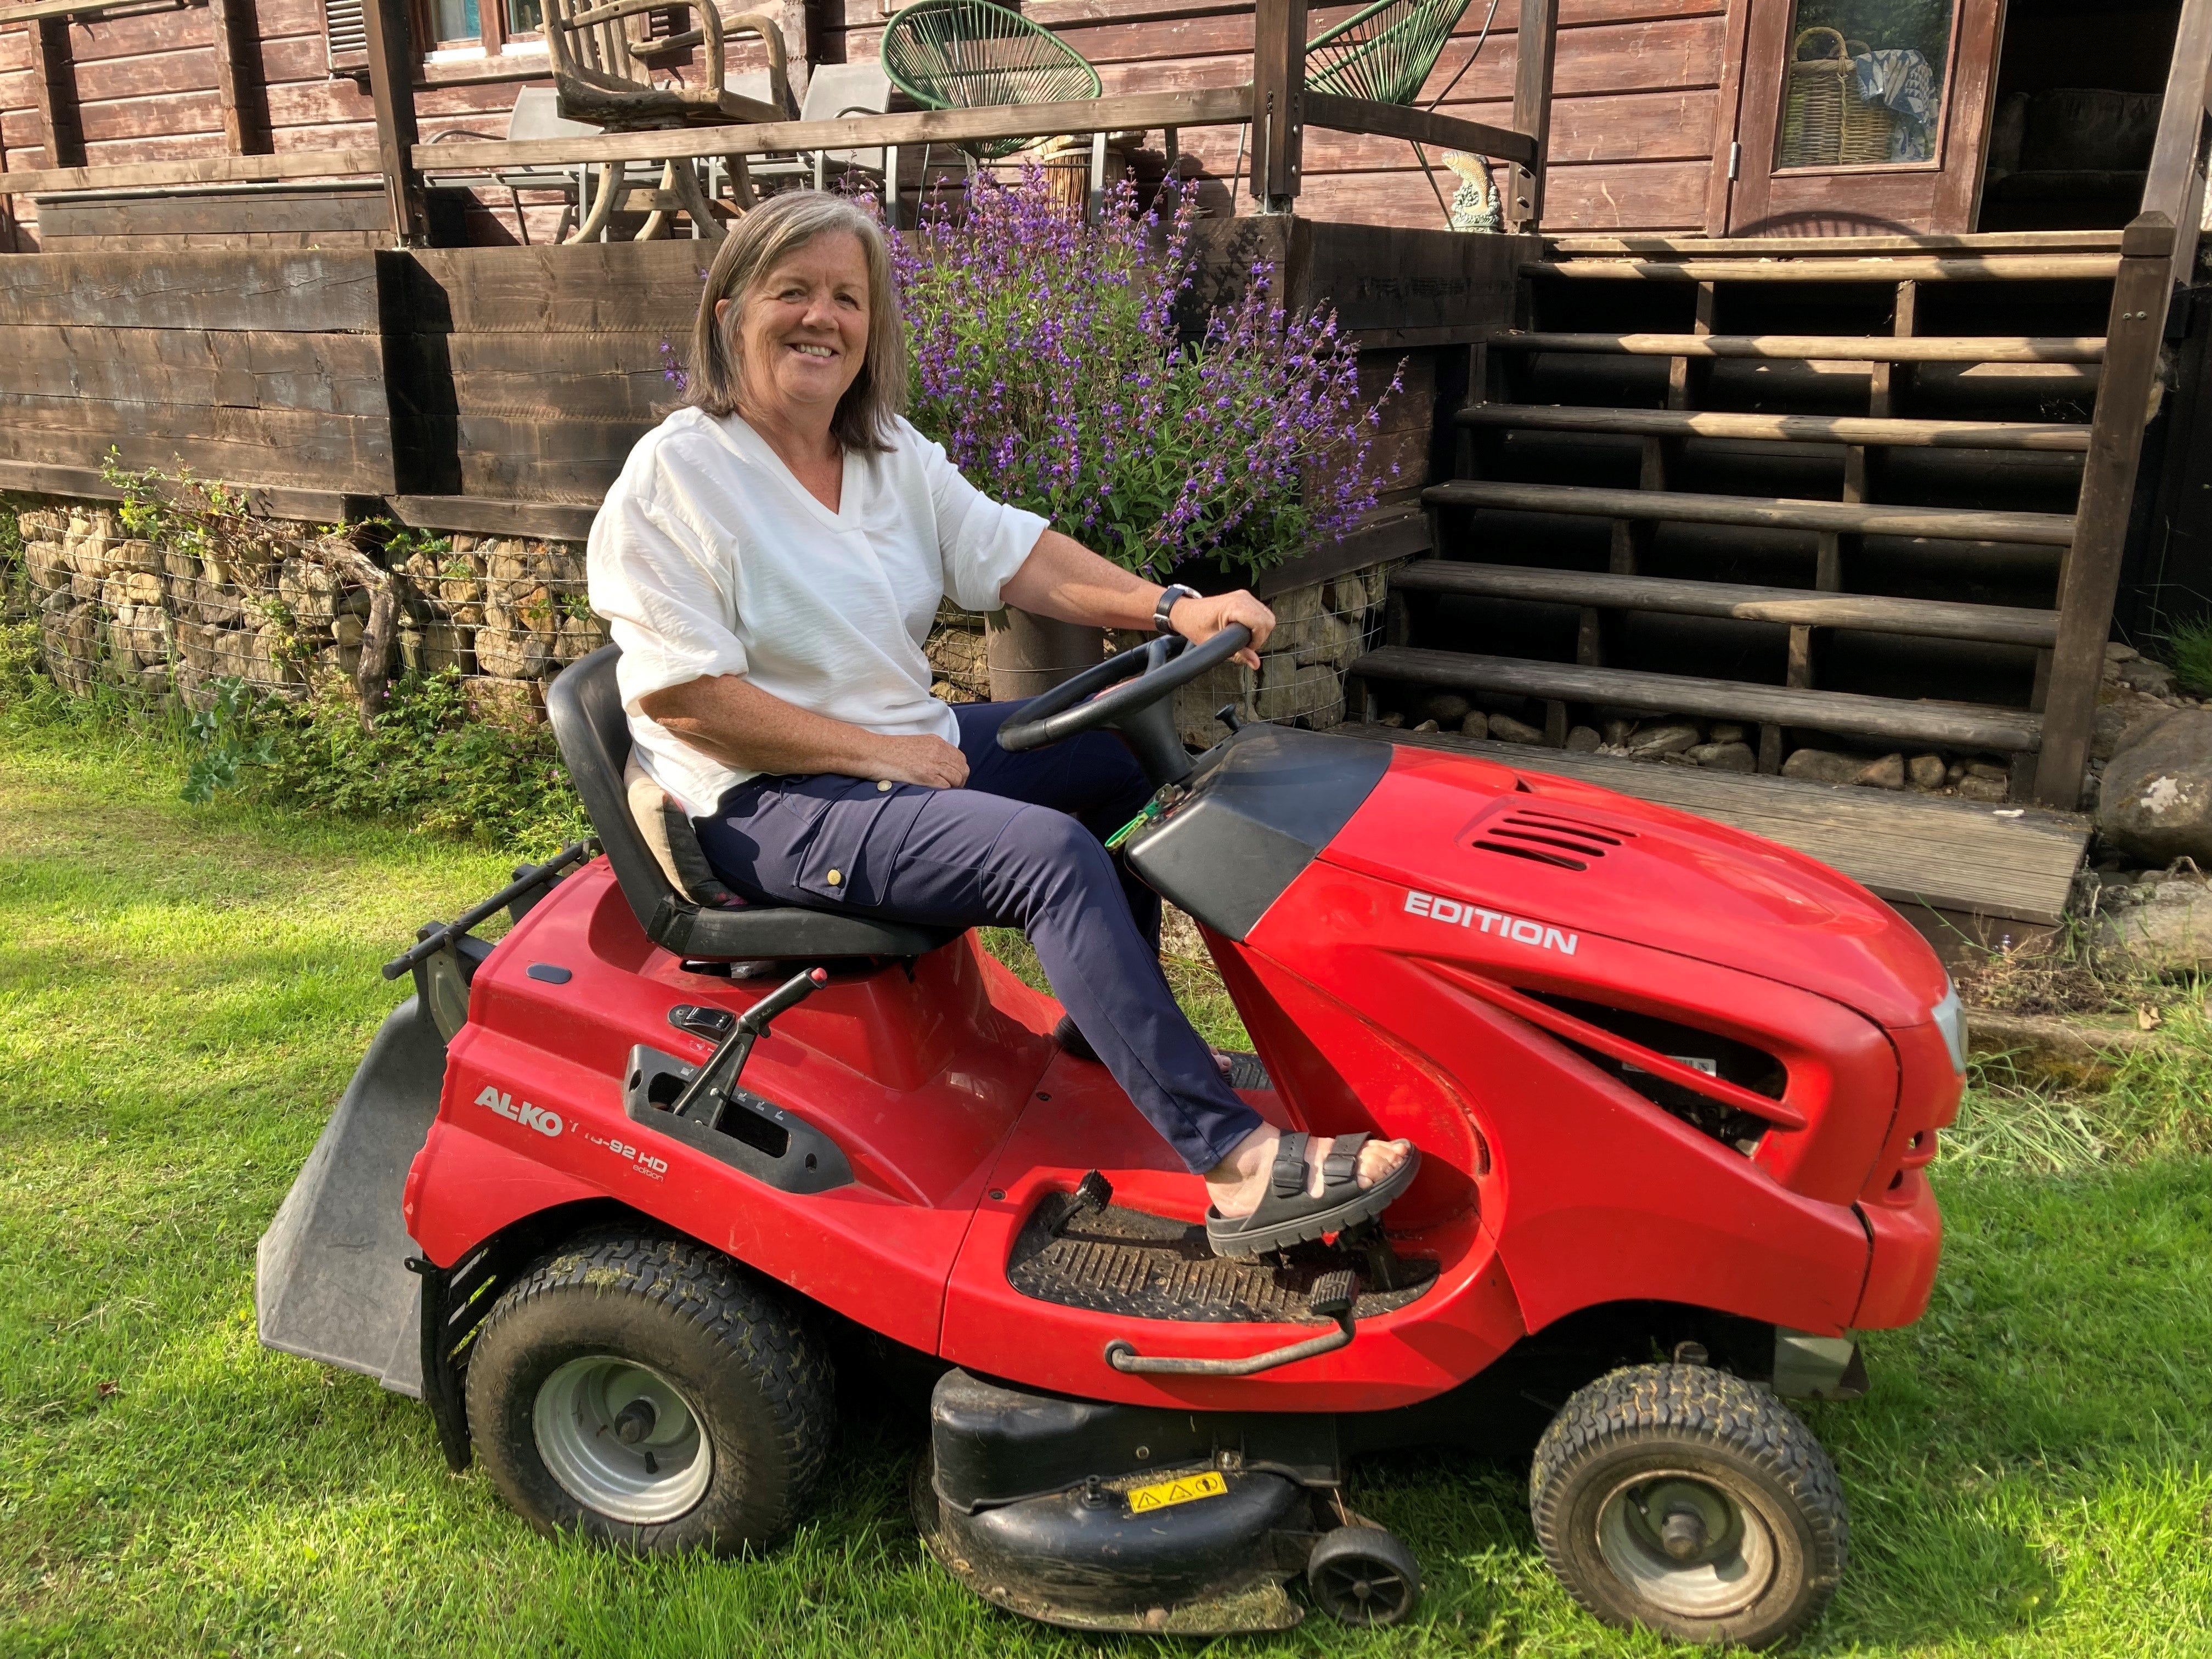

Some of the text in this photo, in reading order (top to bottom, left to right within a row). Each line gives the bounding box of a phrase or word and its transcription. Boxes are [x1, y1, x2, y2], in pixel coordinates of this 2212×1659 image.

[1404, 890, 1579, 955] EDITION
[473, 1086, 563, 1137] AL-KO
[637, 1152, 668, 1173] HD
[632, 1164, 664, 1182] edition
